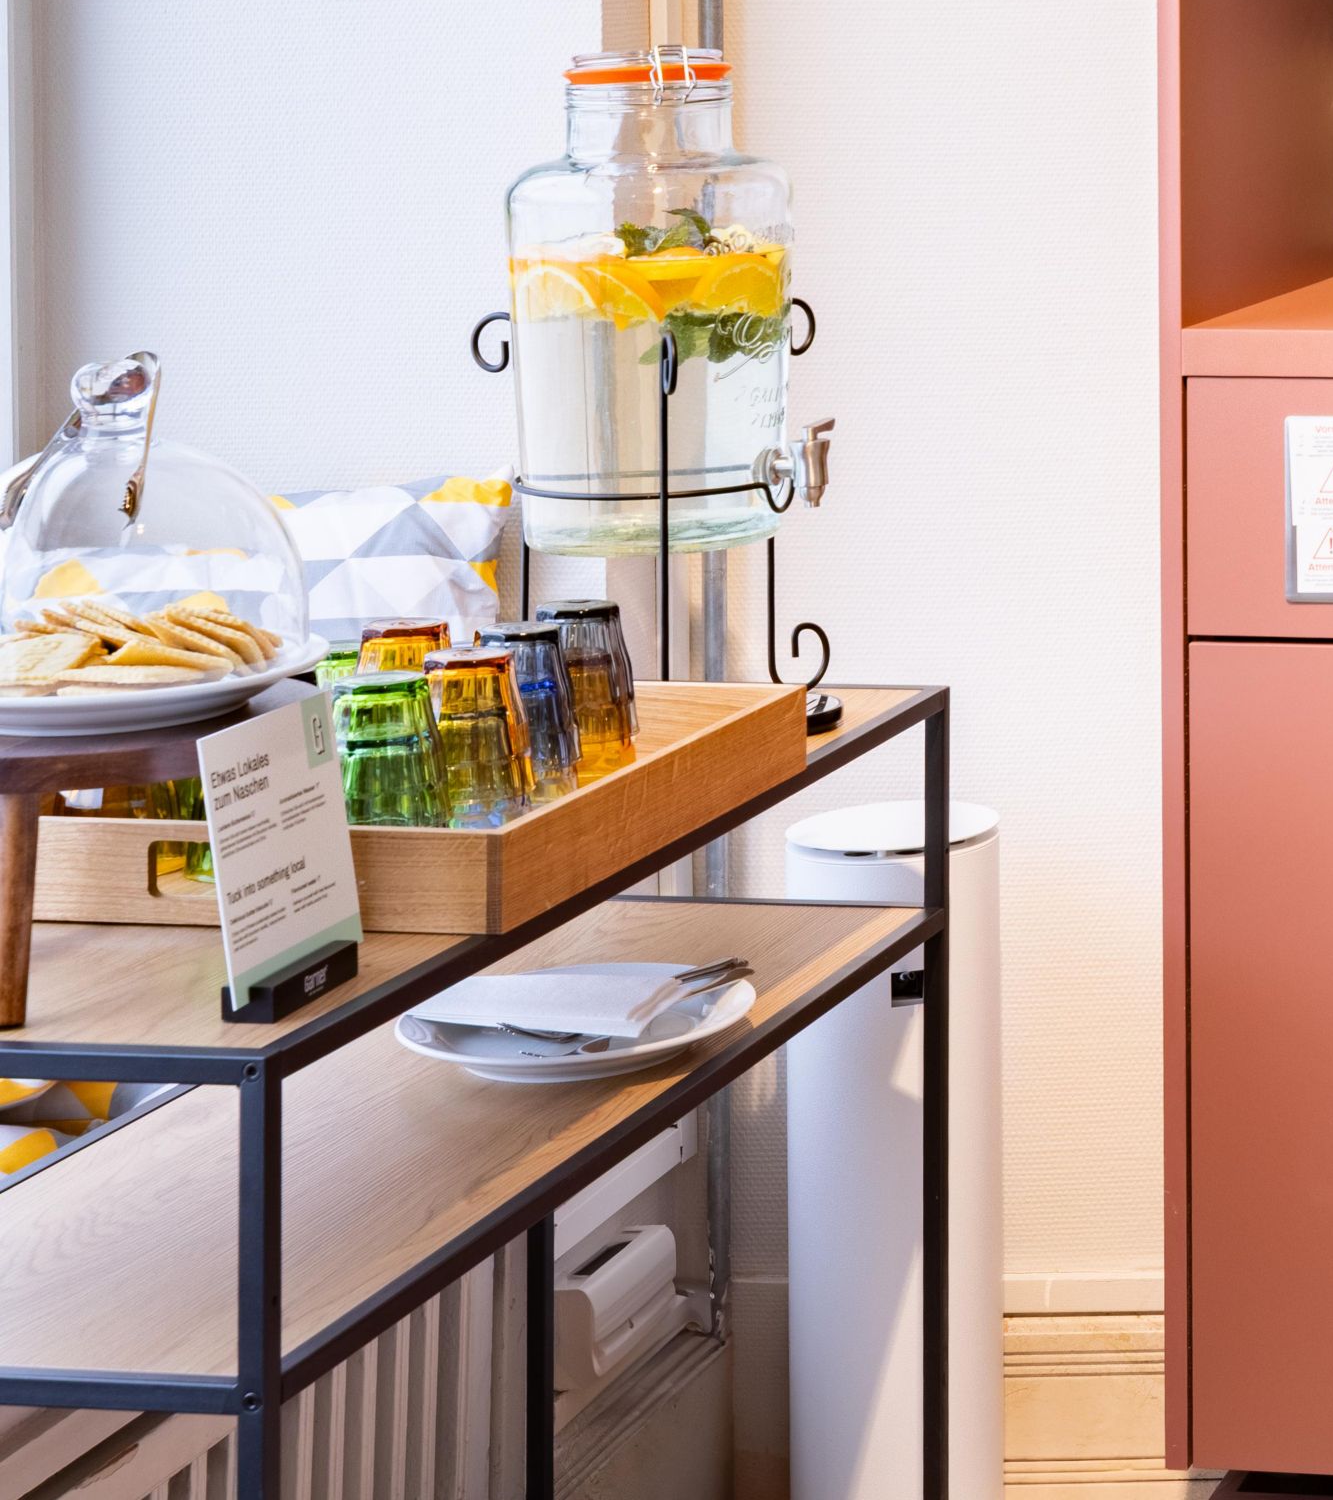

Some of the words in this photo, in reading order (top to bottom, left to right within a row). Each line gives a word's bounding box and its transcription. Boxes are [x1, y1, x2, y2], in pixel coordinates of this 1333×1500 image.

[211, 768, 237, 789] Etwas
[237, 753, 270, 778] Lokales
[214, 792, 233, 812] zum
[233, 775, 270, 803] Naschen
[226, 888, 242, 905] Tuck
[243, 883, 257, 897] into
[257, 866, 291, 891] something
[290, 855, 306, 874] local
